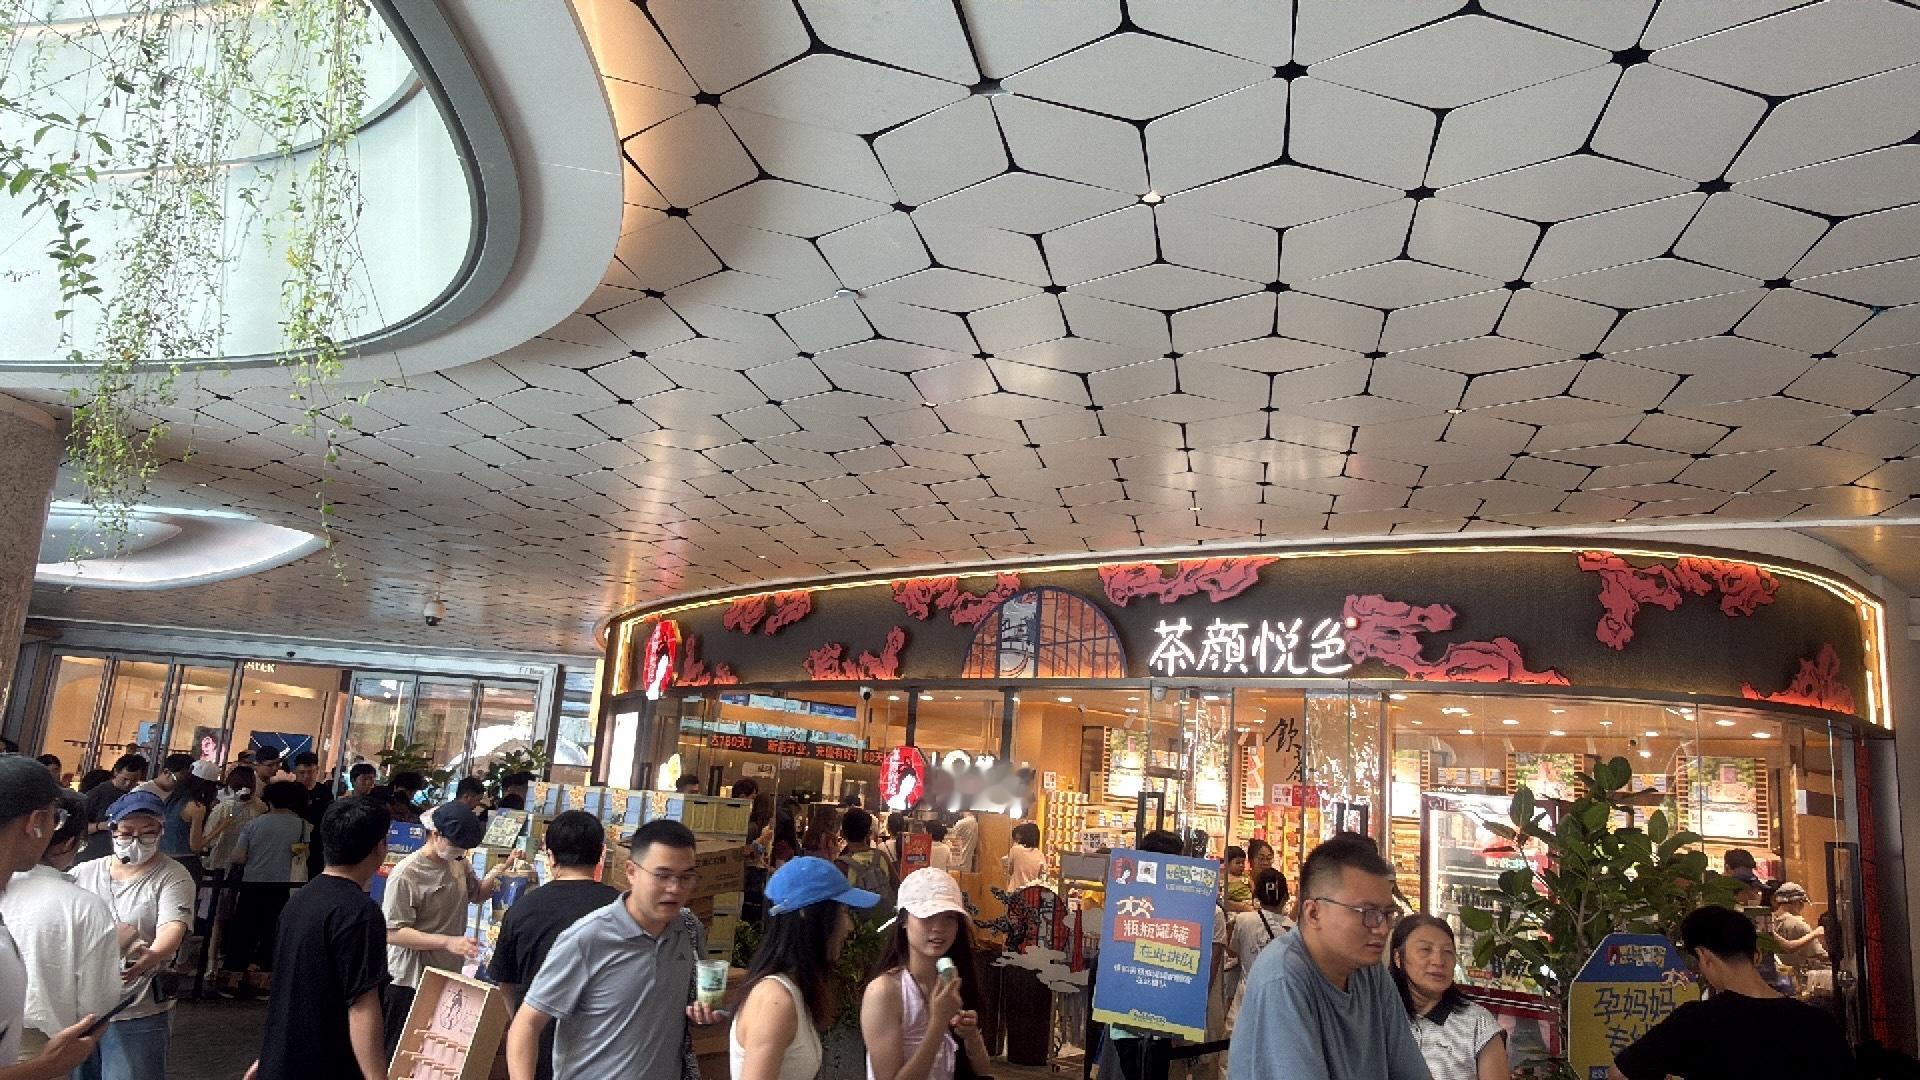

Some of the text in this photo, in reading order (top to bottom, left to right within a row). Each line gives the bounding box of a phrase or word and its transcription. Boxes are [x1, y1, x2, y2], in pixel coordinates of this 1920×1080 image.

[1123, 919, 1190, 945] 瓶瓶罐罐
[1140, 943, 1193, 970] 在此排队
[1594, 987, 1676, 1025] 孕妈妈
